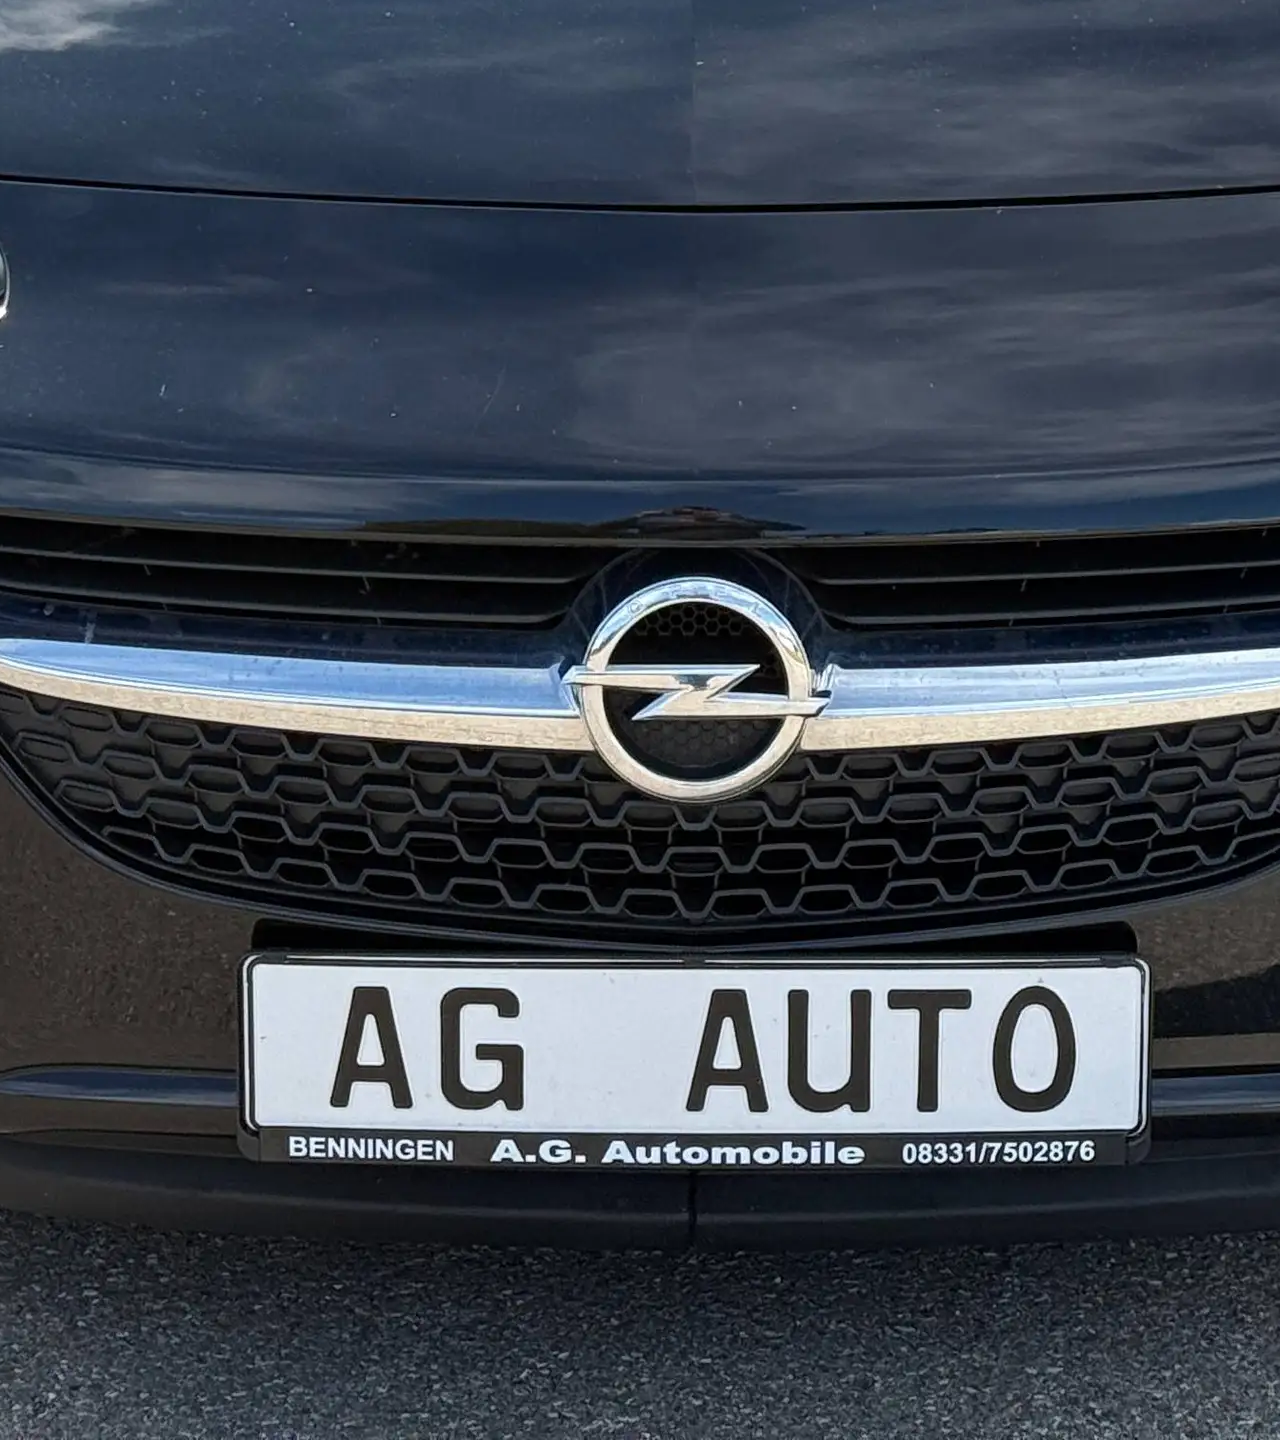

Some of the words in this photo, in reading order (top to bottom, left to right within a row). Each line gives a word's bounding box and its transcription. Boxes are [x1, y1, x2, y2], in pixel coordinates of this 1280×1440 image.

[330, 987, 523, 1111] AG
[686, 986, 1076, 1112] AUTO
[289, 1135, 454, 1161] BENNINGEN
[490, 1139, 586, 1164] A.G.
[601, 1140, 866, 1165] Automobile
[902, 1140, 1095, 1164] 08331/7502876
